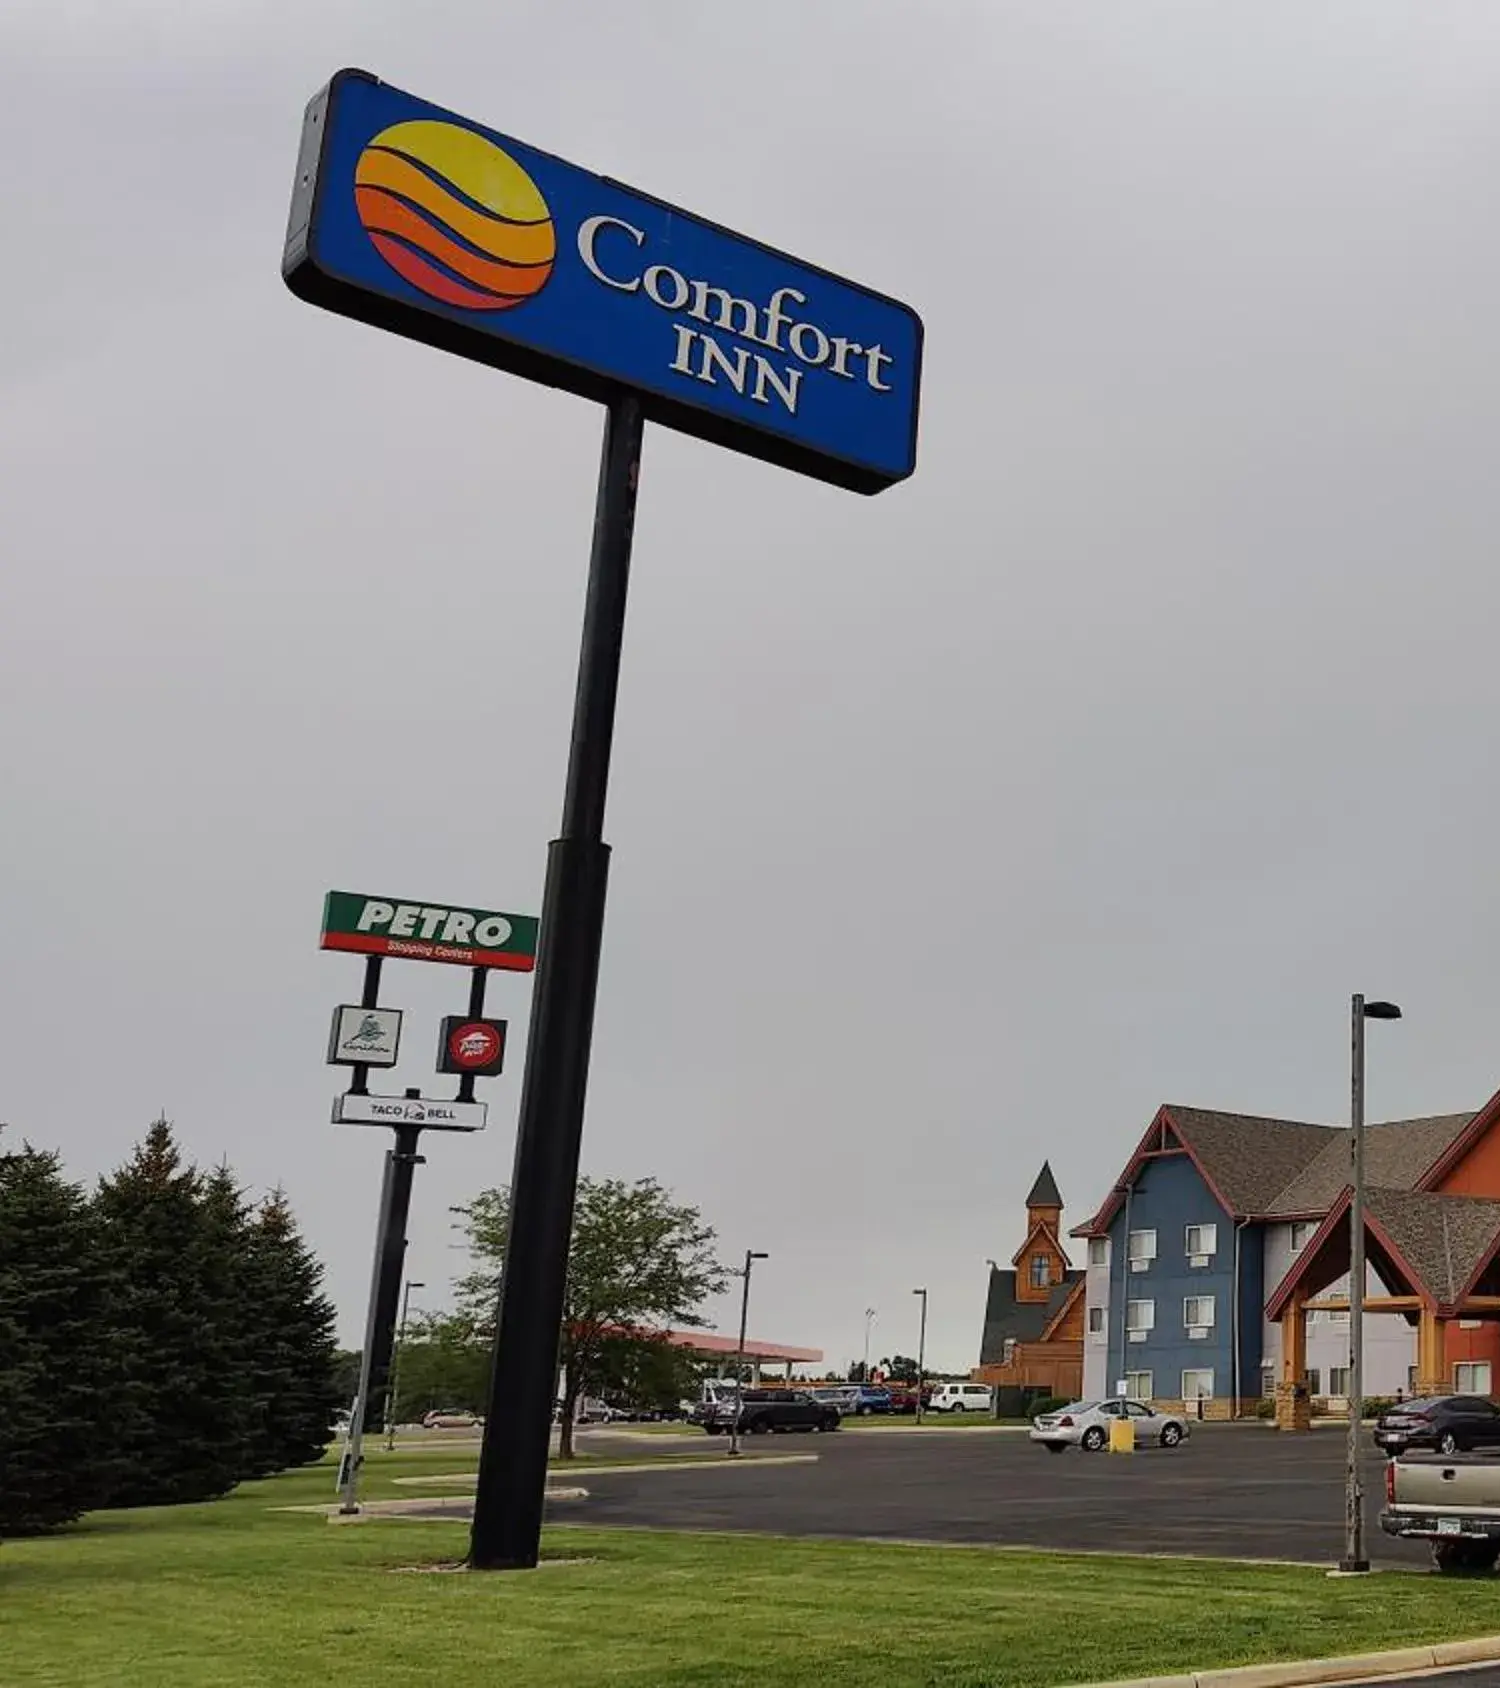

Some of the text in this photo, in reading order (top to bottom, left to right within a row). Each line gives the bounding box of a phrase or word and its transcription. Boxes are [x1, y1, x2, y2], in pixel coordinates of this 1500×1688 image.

[576, 214, 893, 391] Comfort
[668, 323, 803, 414] INN
[356, 900, 513, 947] PETRO
[371, 1104, 457, 1119] TACO BELL
